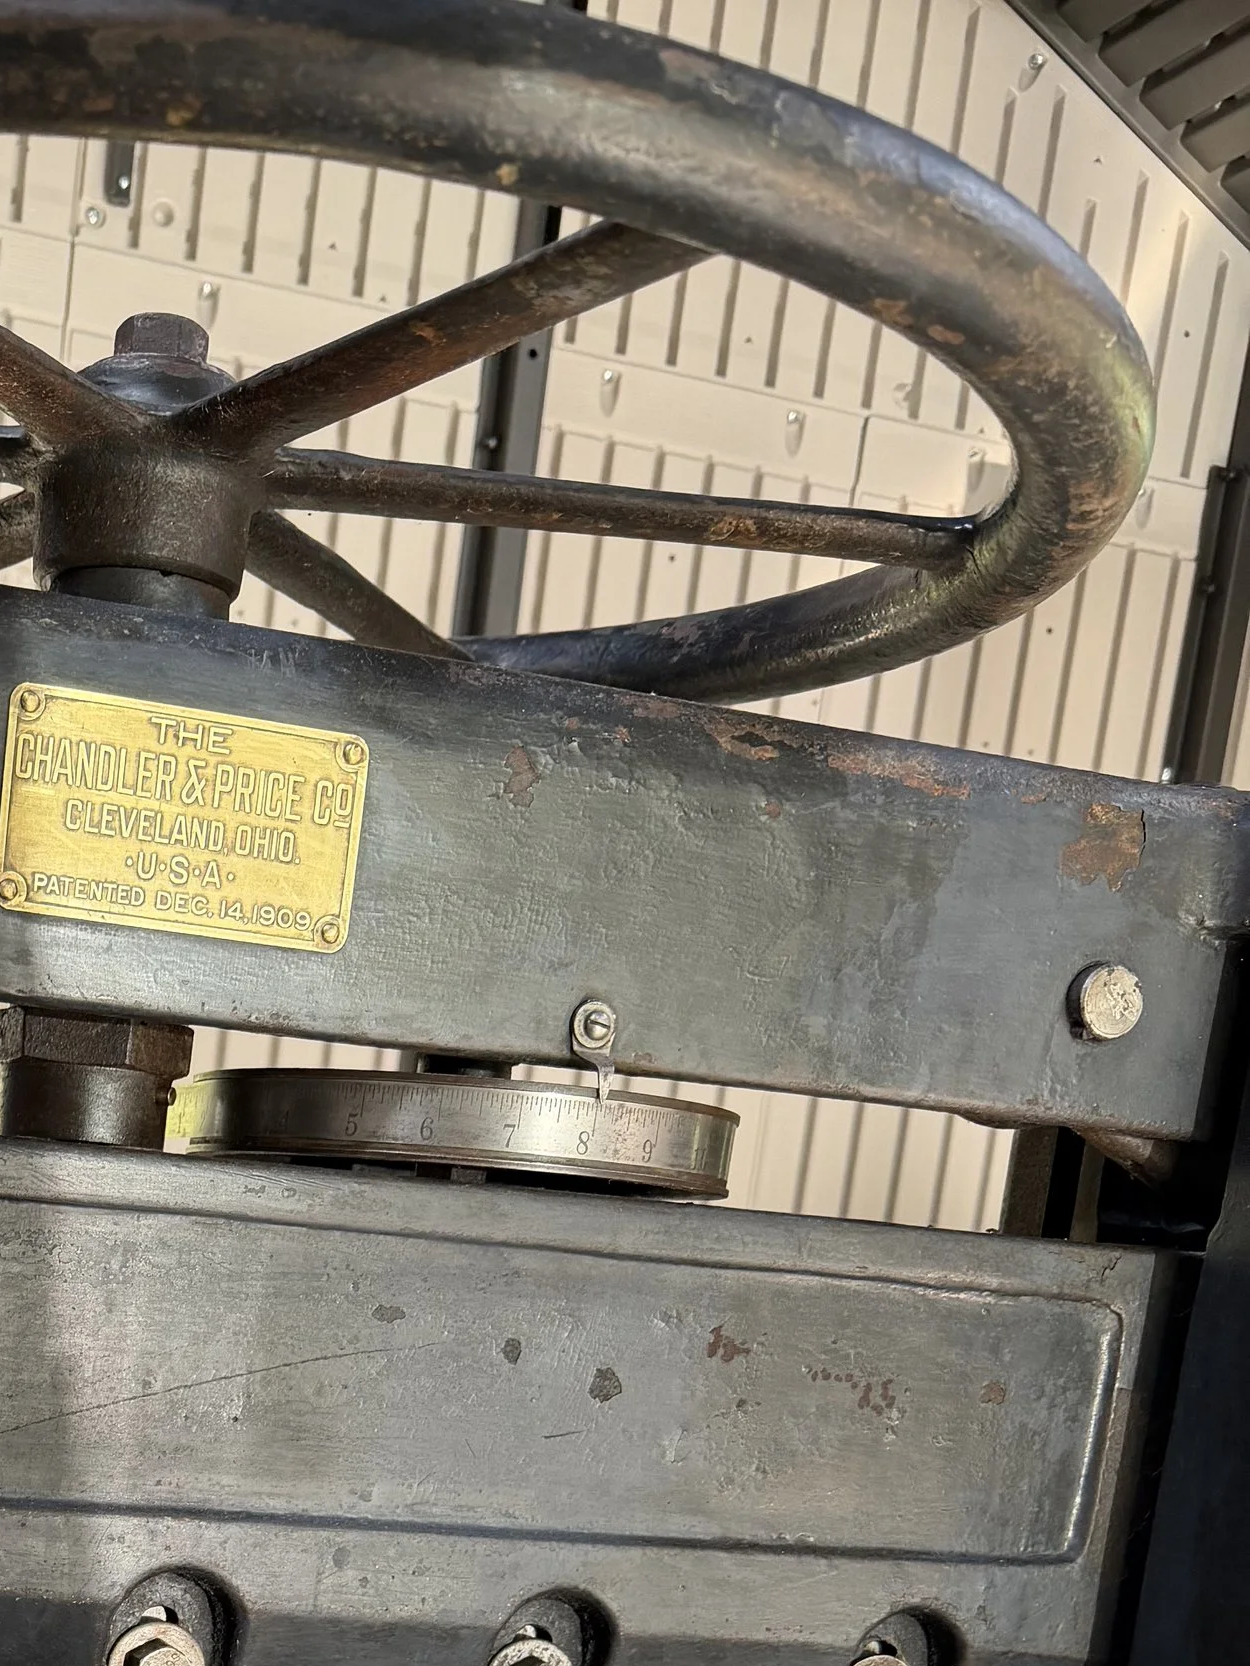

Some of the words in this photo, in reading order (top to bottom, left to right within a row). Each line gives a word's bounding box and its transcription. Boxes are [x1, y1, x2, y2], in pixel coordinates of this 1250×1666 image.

[151, 716, 233, 755] THE
[14, 732, 178, 802] CHANDLER
[180, 757, 208, 807] &
[212, 763, 306, 822] PRICE
[64, 798, 229, 857] CLEVELAND,
[234, 824, 301, 865] OHIO.
[32, 871, 146, 907] PATENTED
[155, 889, 214, 918] DEC.
[344, 1112, 359, 1137] 5
[419, 1116, 435, 1141] 6
[502, 1123, 517, 1149] 7
[575, 1130, 591, 1156] 8
[641, 1138, 655, 1163] 9
